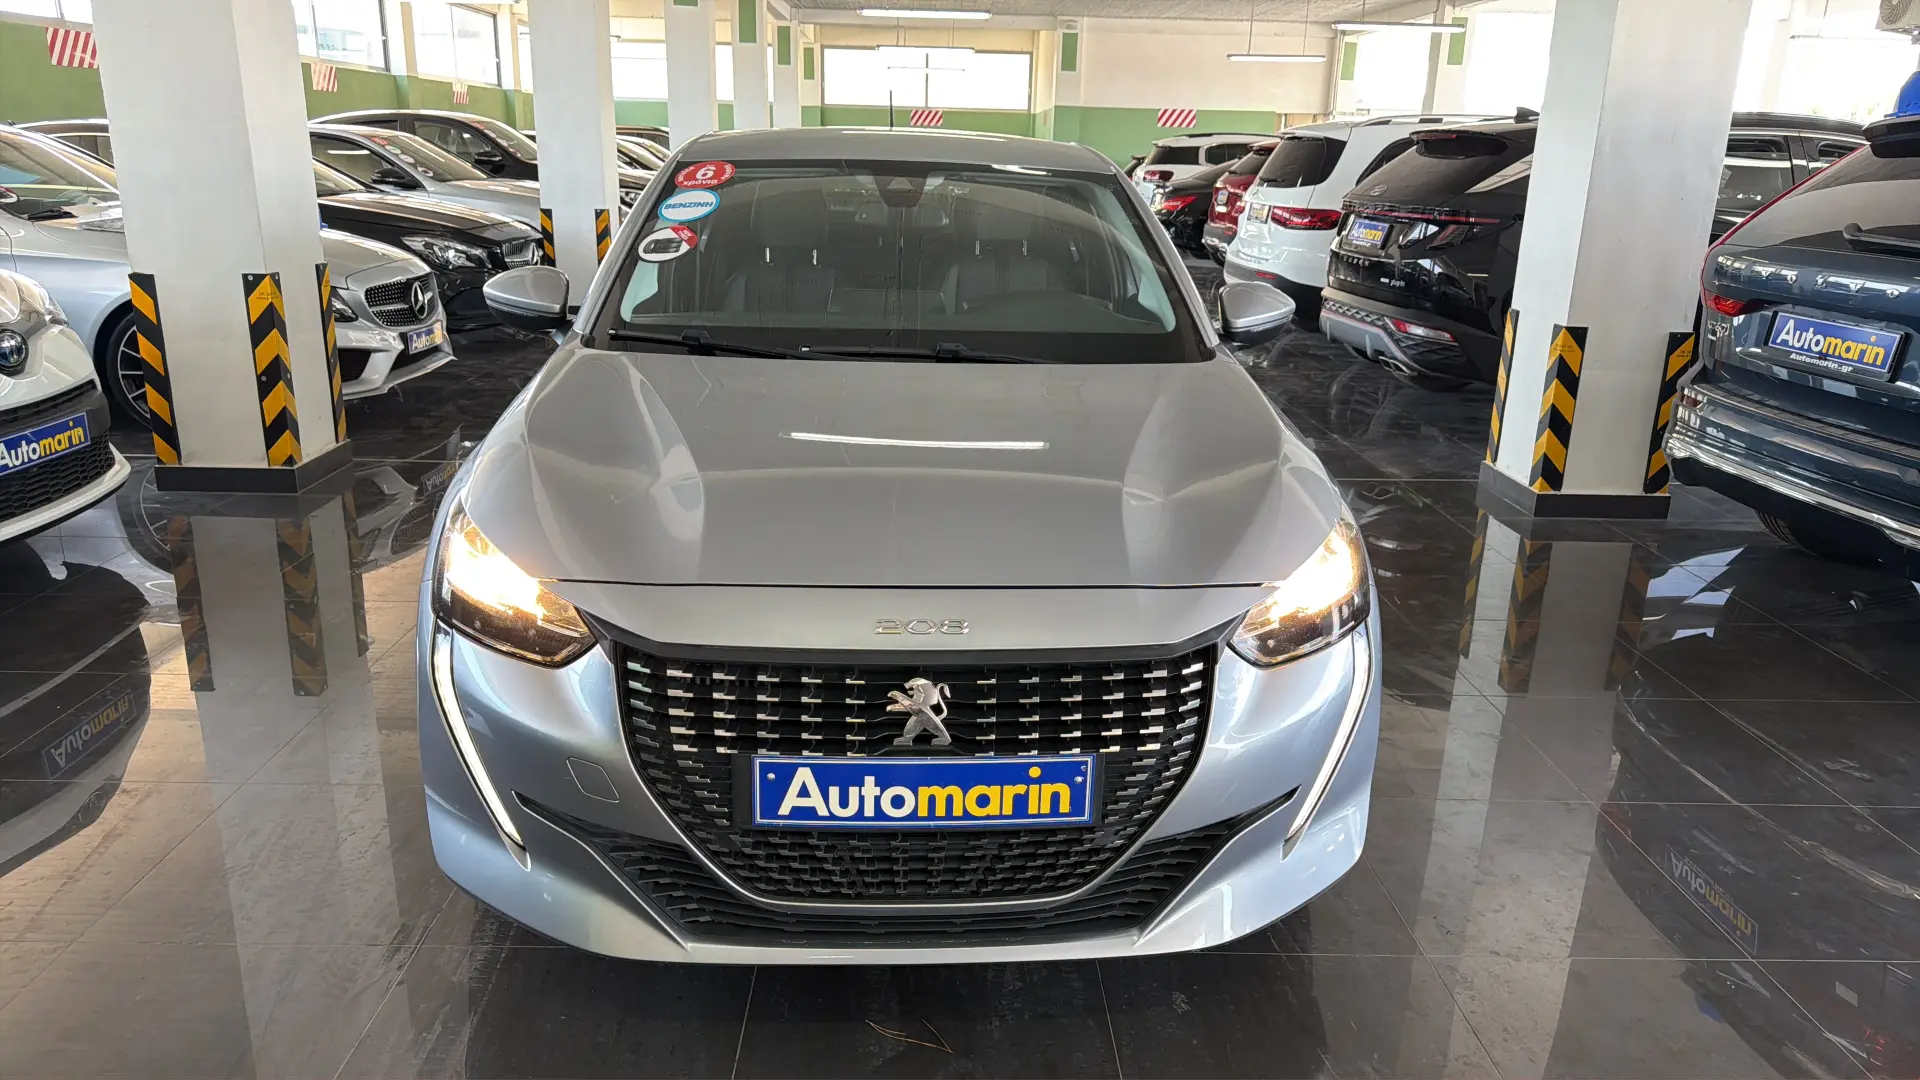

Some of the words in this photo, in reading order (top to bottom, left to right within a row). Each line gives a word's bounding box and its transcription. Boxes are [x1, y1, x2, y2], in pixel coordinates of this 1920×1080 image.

[696, 166, 716, 179] 6
[1776, 319, 1885, 365] Automarin
[1789, 352, 1853, 373] Automarin.gr
[0, 421, 84, 467] Automarin
[873, 618, 969, 635] 208
[777, 766, 1071, 817] Automarin
